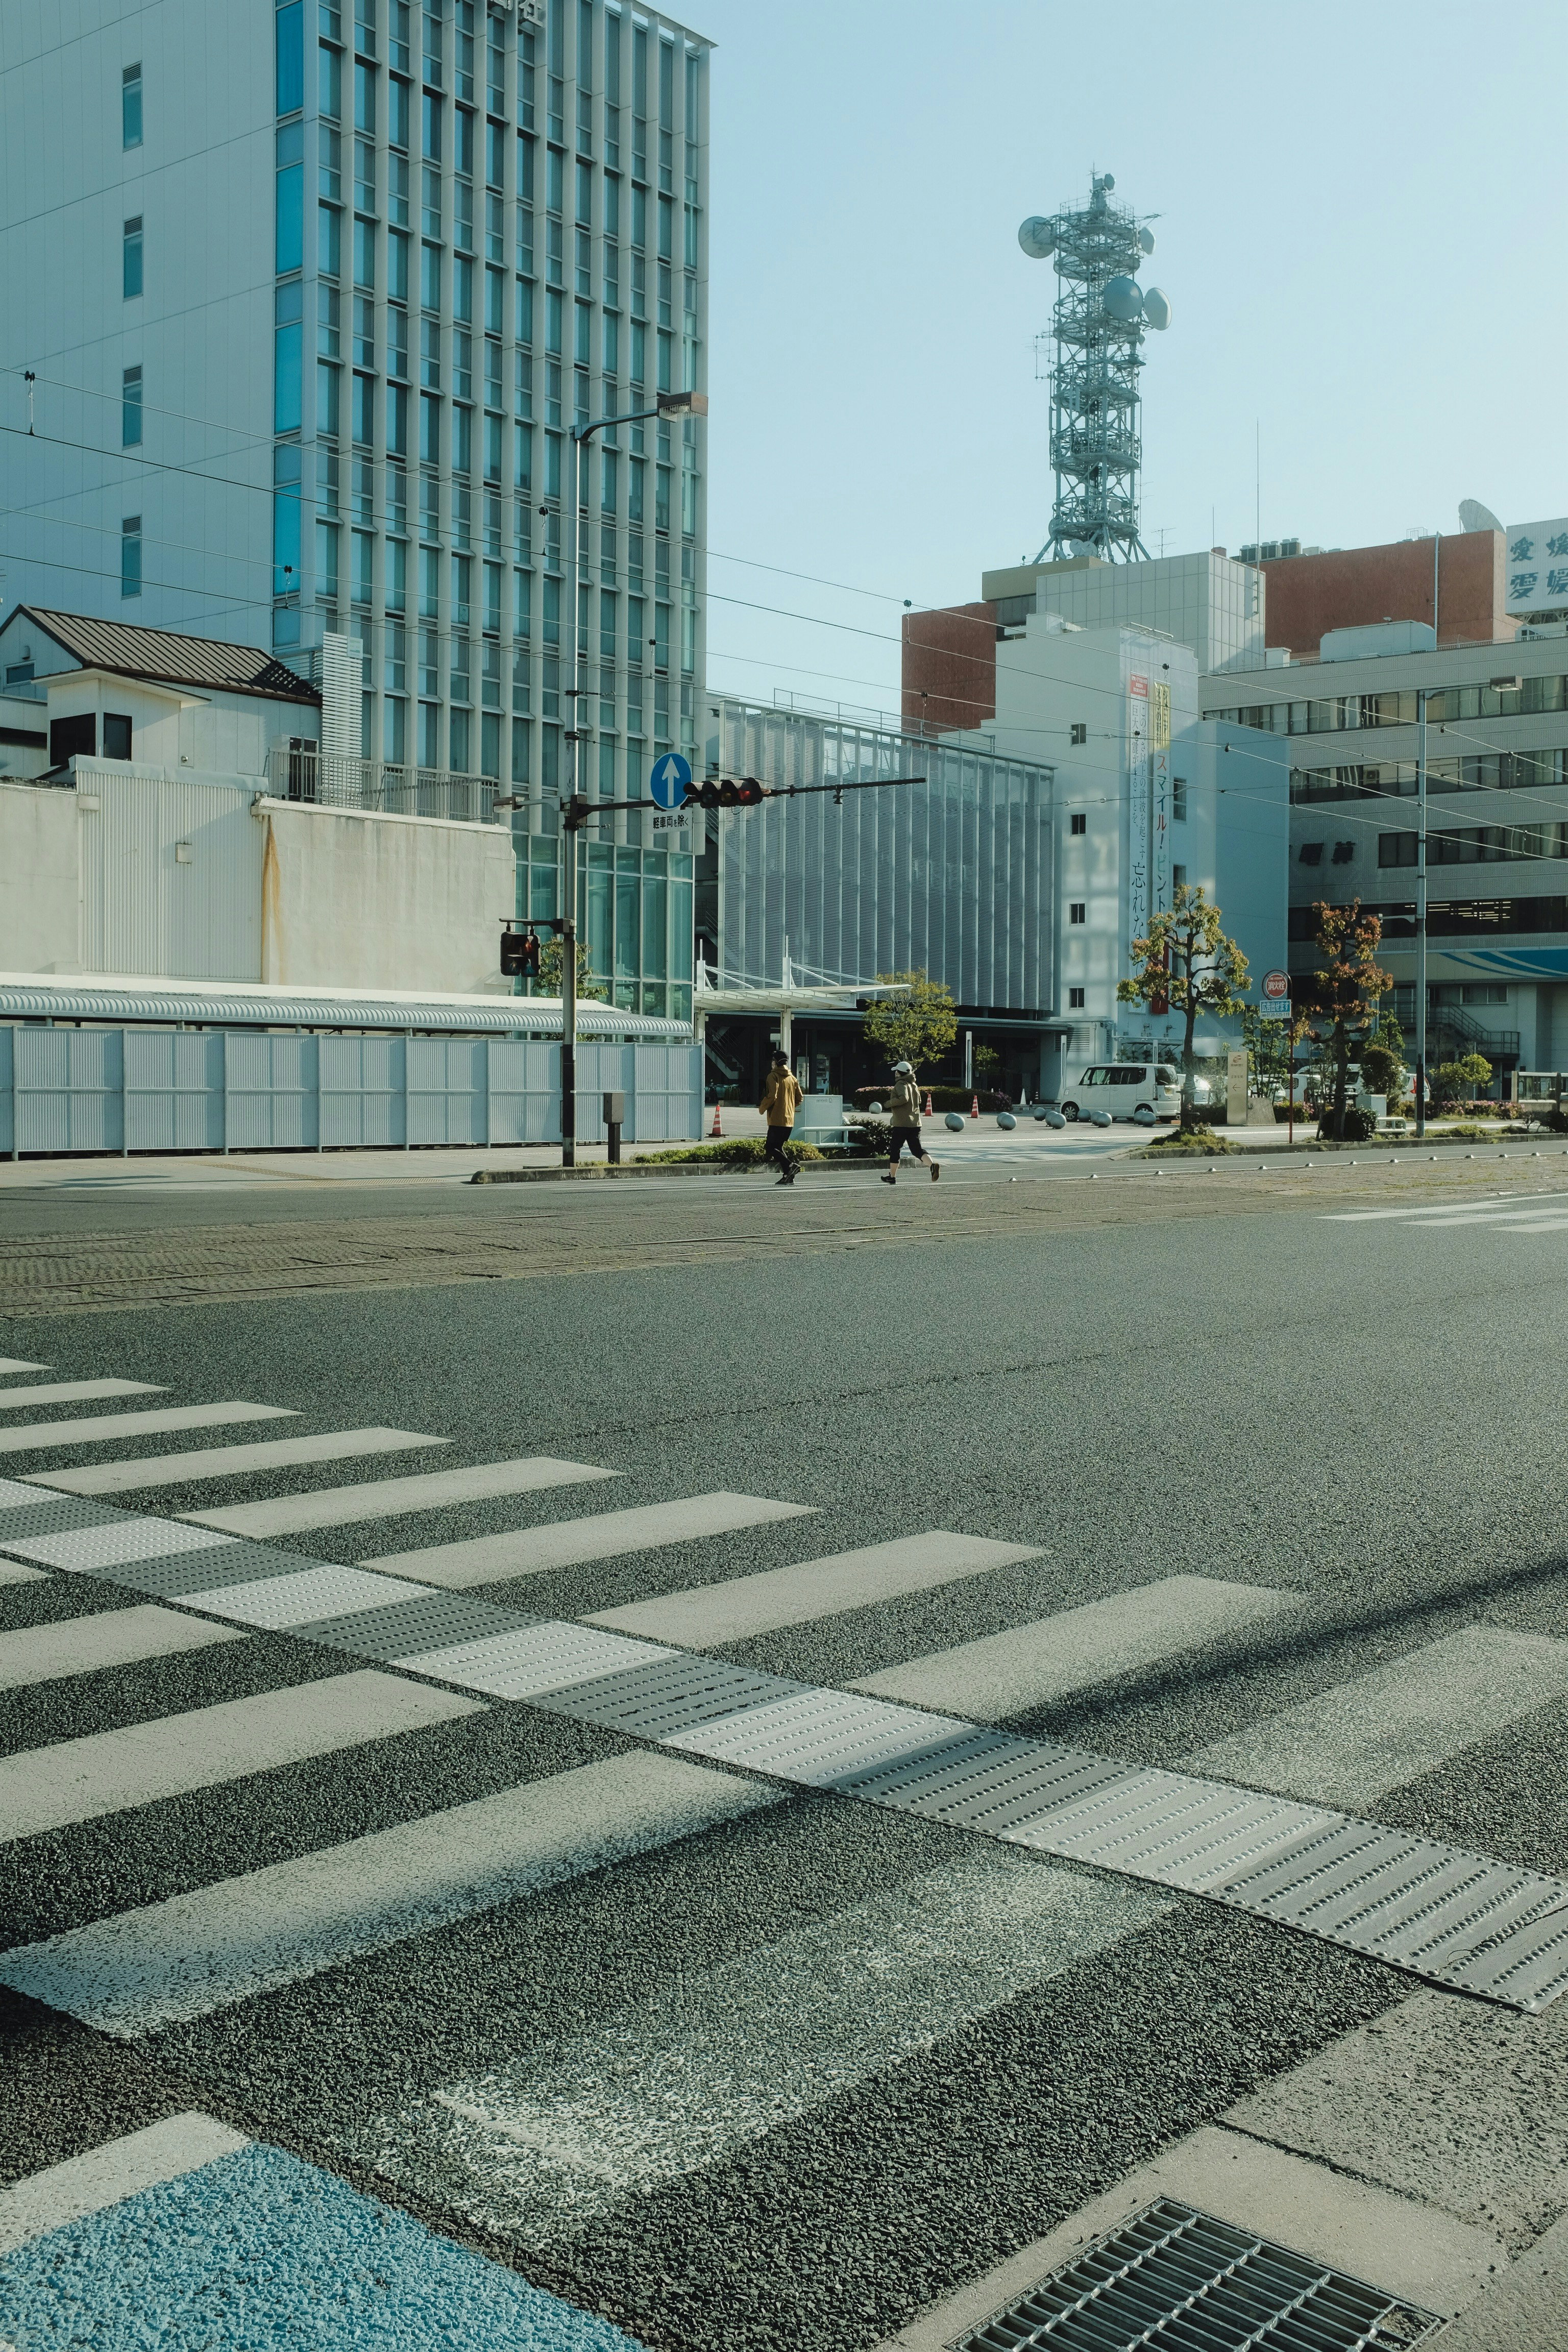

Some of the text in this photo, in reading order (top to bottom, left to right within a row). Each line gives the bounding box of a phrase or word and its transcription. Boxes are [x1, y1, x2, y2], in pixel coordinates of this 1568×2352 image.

[1510, 532, 1568, 562] 愛媛
[653, 815, 689, 829] 軽車両を除く
[1131, 862, 1147, 978] 忘れなで
[1267, 981, 1285, 991] 消火栓
[1261, 1001, 1289, 1013] 広告出せます
